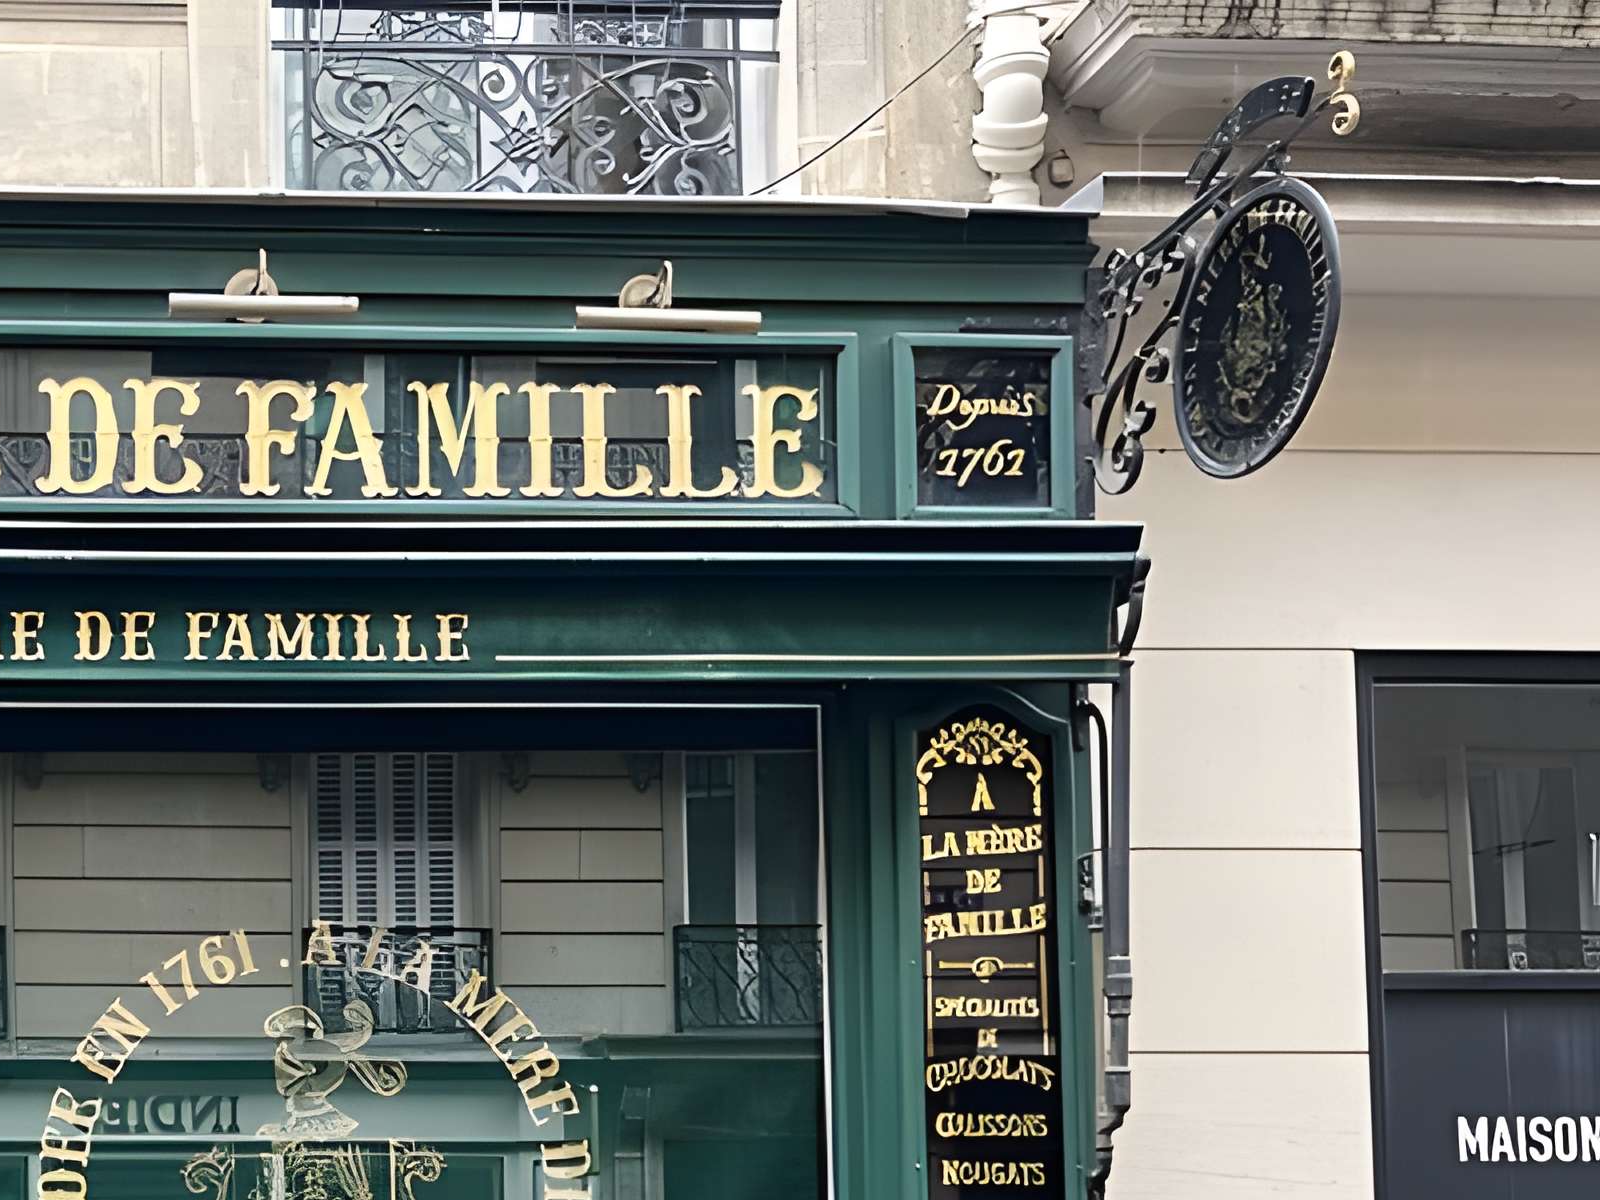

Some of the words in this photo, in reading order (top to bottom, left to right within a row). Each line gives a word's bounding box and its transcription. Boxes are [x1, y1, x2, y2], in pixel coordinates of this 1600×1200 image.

[34, 376, 203, 496] DE
[235, 379, 825, 499] FAMILLE
[936, 439, 1026, 488] 1761
[74, 610, 156, 662] DE
[184, 610, 471, 663] FAMILLE
[922, 831, 960, 861] LA
[966, 869, 1001, 894] DE
[924, 903, 1047, 944] FAMILLE
[69, 996, 151, 1085] EN
[139, 928, 261, 1016] 1761
[1457, 1115, 1600, 1162] MAISON
[942, 1159, 1045, 1186] NOUGATS
